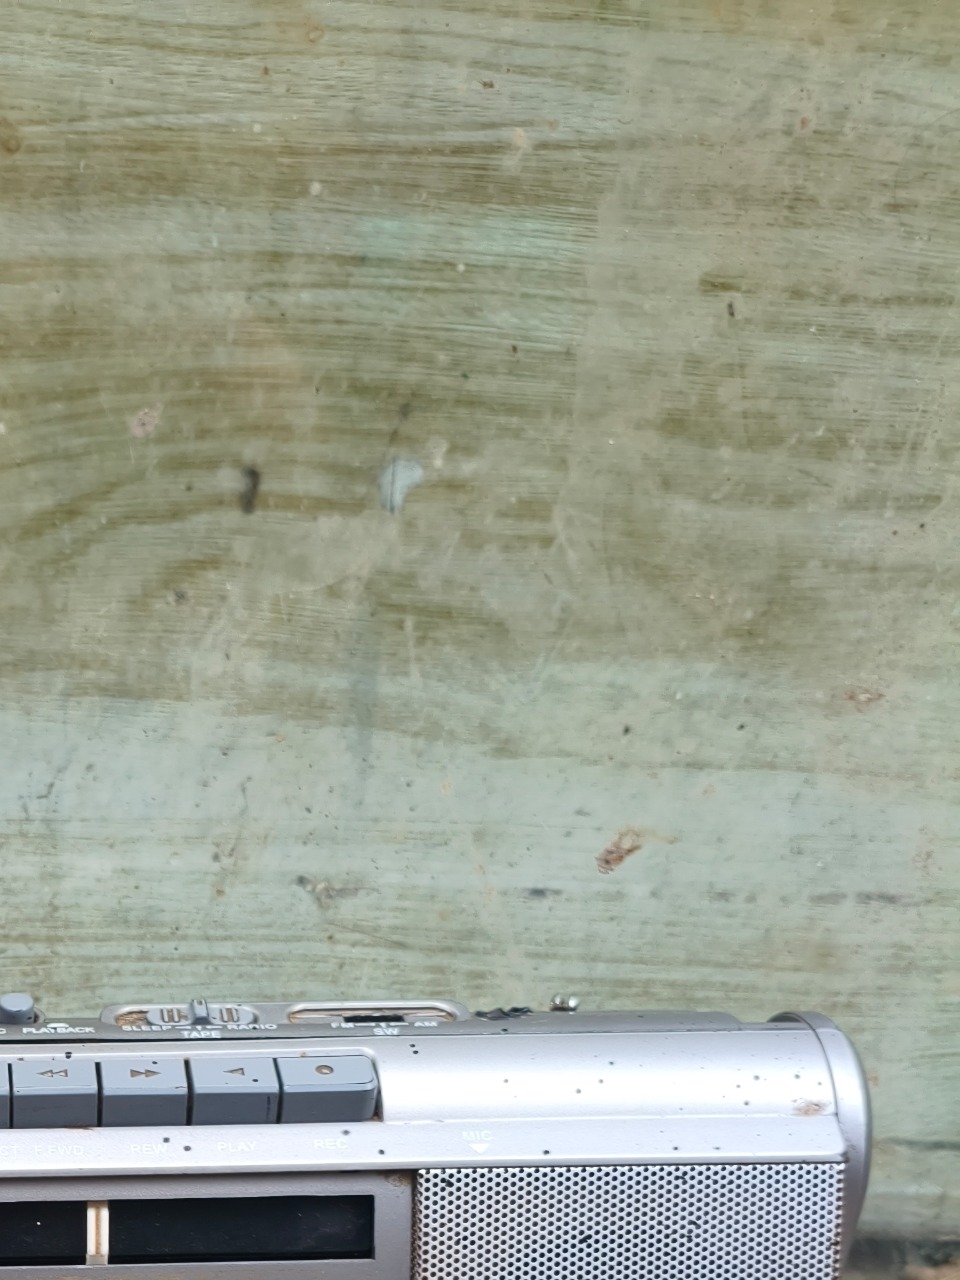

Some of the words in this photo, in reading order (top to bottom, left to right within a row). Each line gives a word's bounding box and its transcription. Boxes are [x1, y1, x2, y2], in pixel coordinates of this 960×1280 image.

[22, 1026, 96, 1035] PLAYBACK
[180, 1030, 221, 1039] TAPE
[373, 1027, 399, 1035] SW
[461, 1130, 493, 1141] MIC
[130, 1143, 168, 1155] REW
[216, 1141, 257, 1153] PLAY
[313, 1138, 349, 1150] REC
